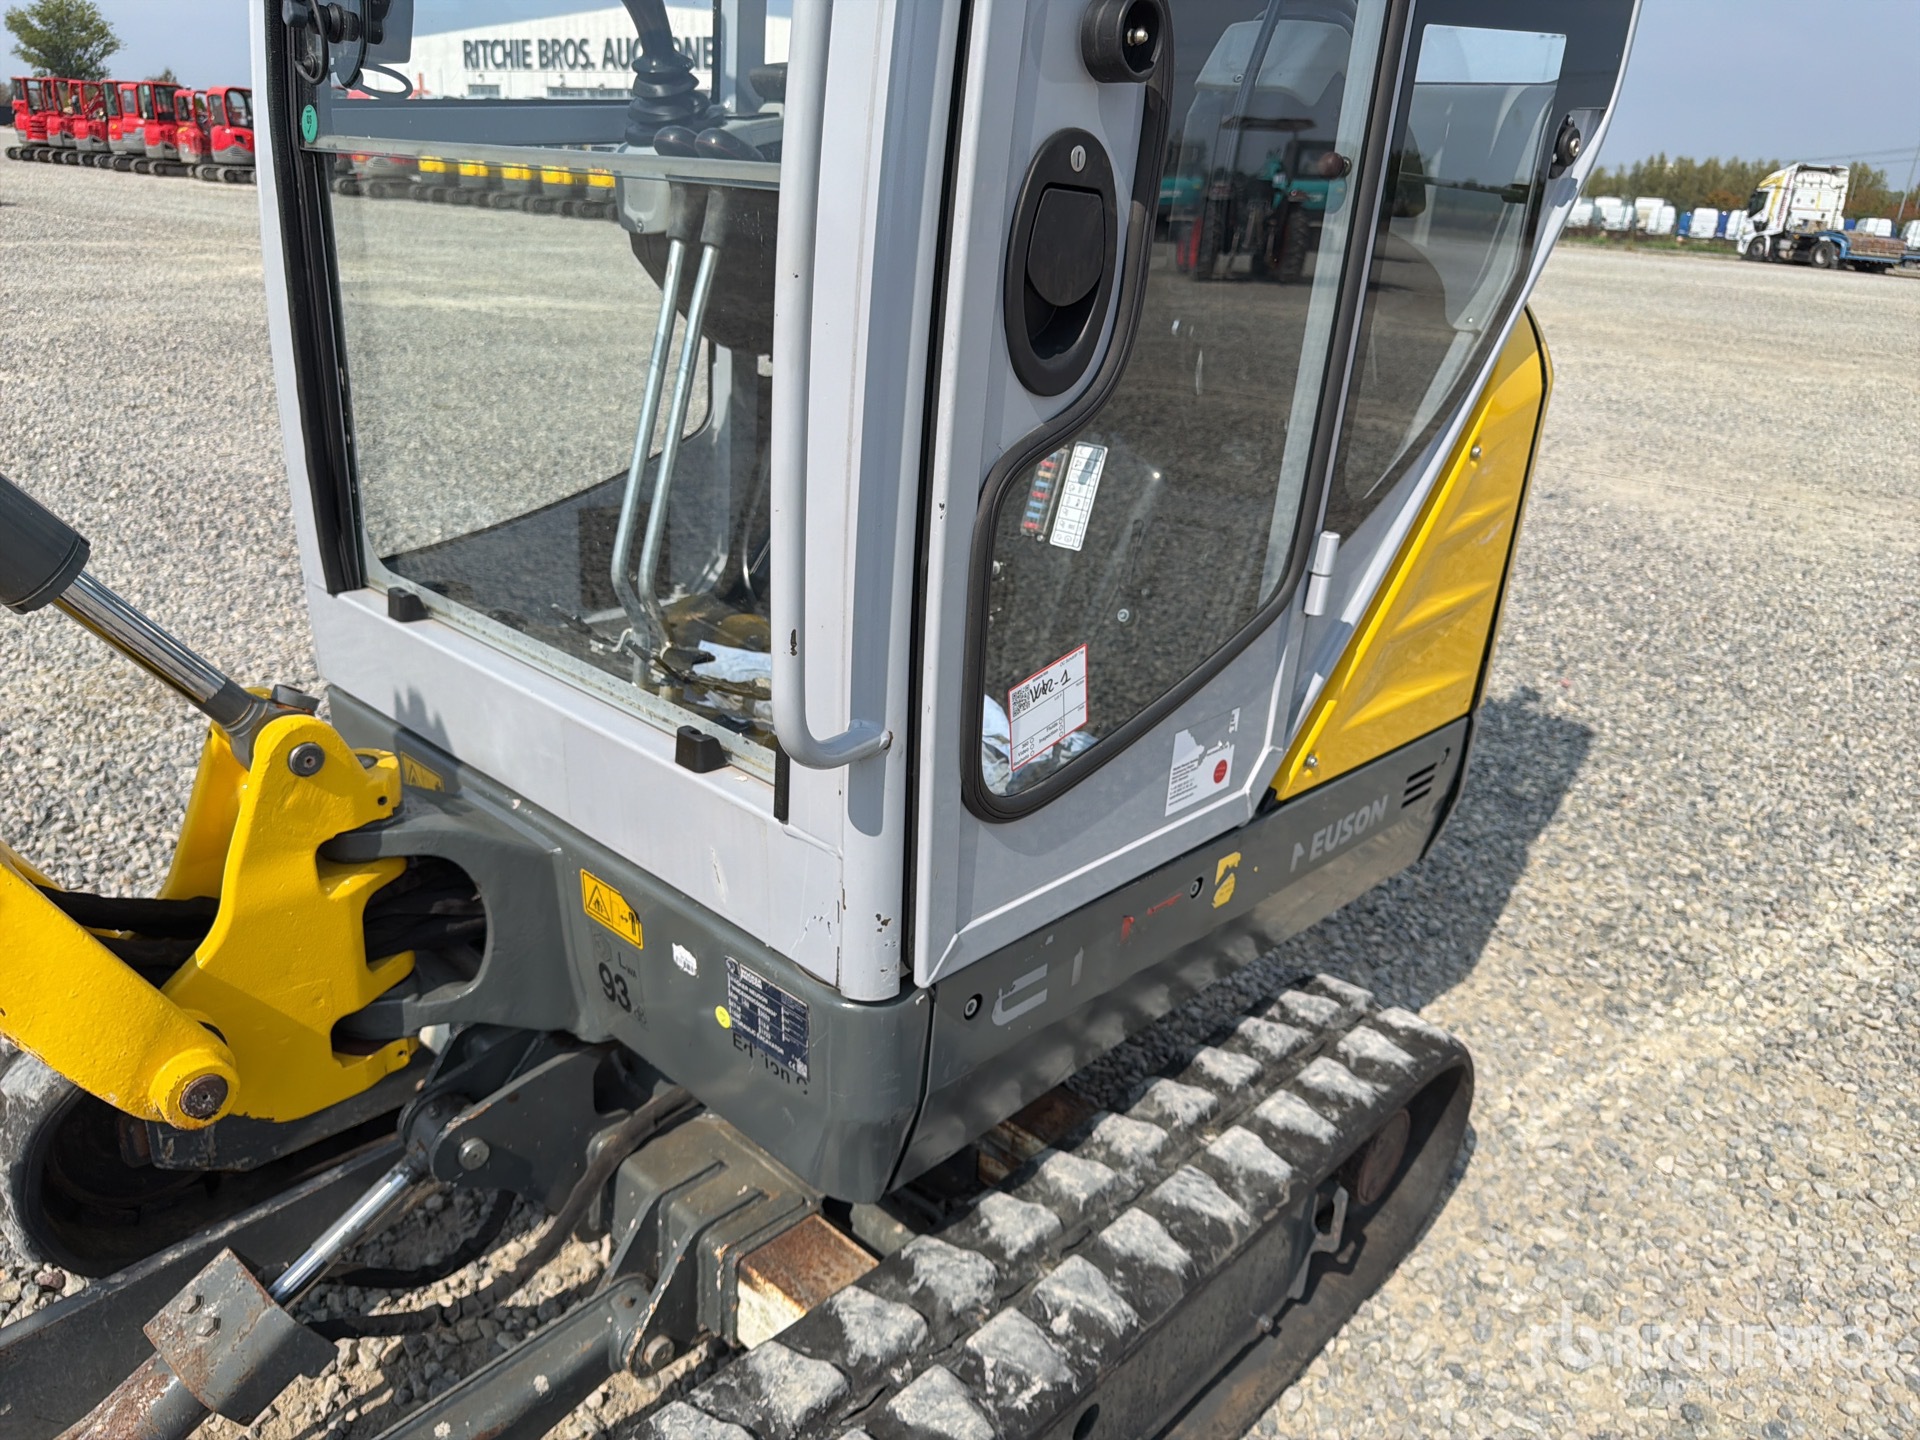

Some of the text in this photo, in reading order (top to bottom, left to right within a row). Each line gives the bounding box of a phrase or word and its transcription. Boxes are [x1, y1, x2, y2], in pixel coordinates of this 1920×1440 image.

[463, 38, 533, 70] RITCHIE
[538, 38, 595, 70] BROS.
[598, 961, 633, 1014] 93
